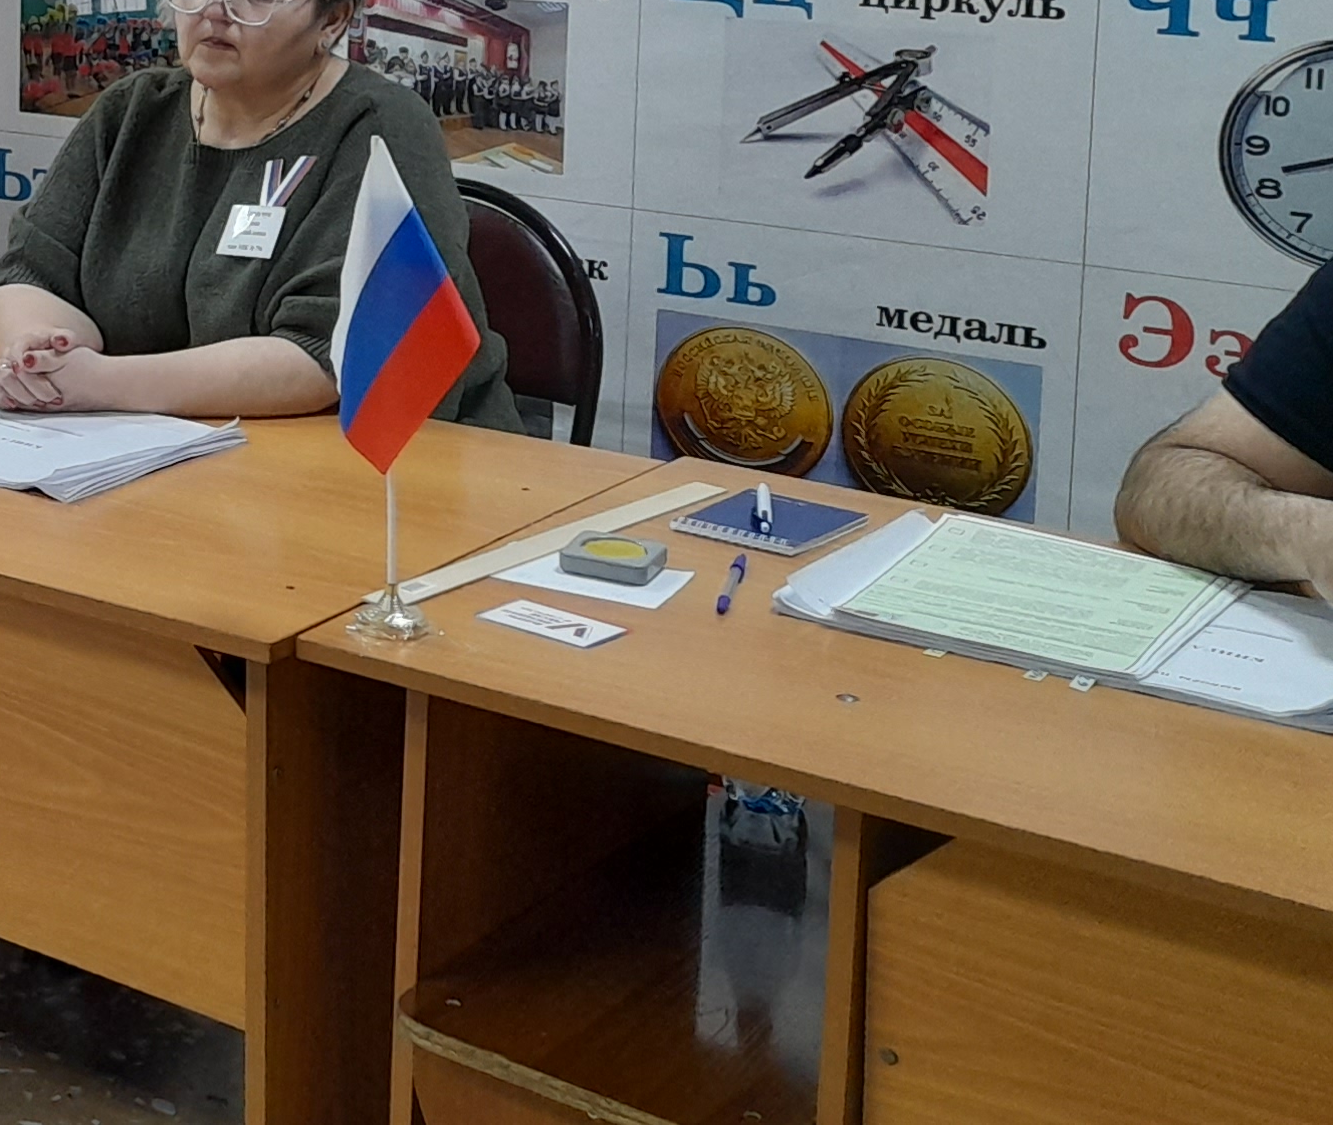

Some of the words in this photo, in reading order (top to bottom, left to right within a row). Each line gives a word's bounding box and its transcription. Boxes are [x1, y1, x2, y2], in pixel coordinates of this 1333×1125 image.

[1305, 68, 1324, 90] 11
[1264, 95, 1290, 117] 10
[1245, 135, 1270, 156] 9
[1255, 178, 1283, 199] 8
[1289, 211, 1313, 233] 7
[876, 303, 1047, 352] медаль
